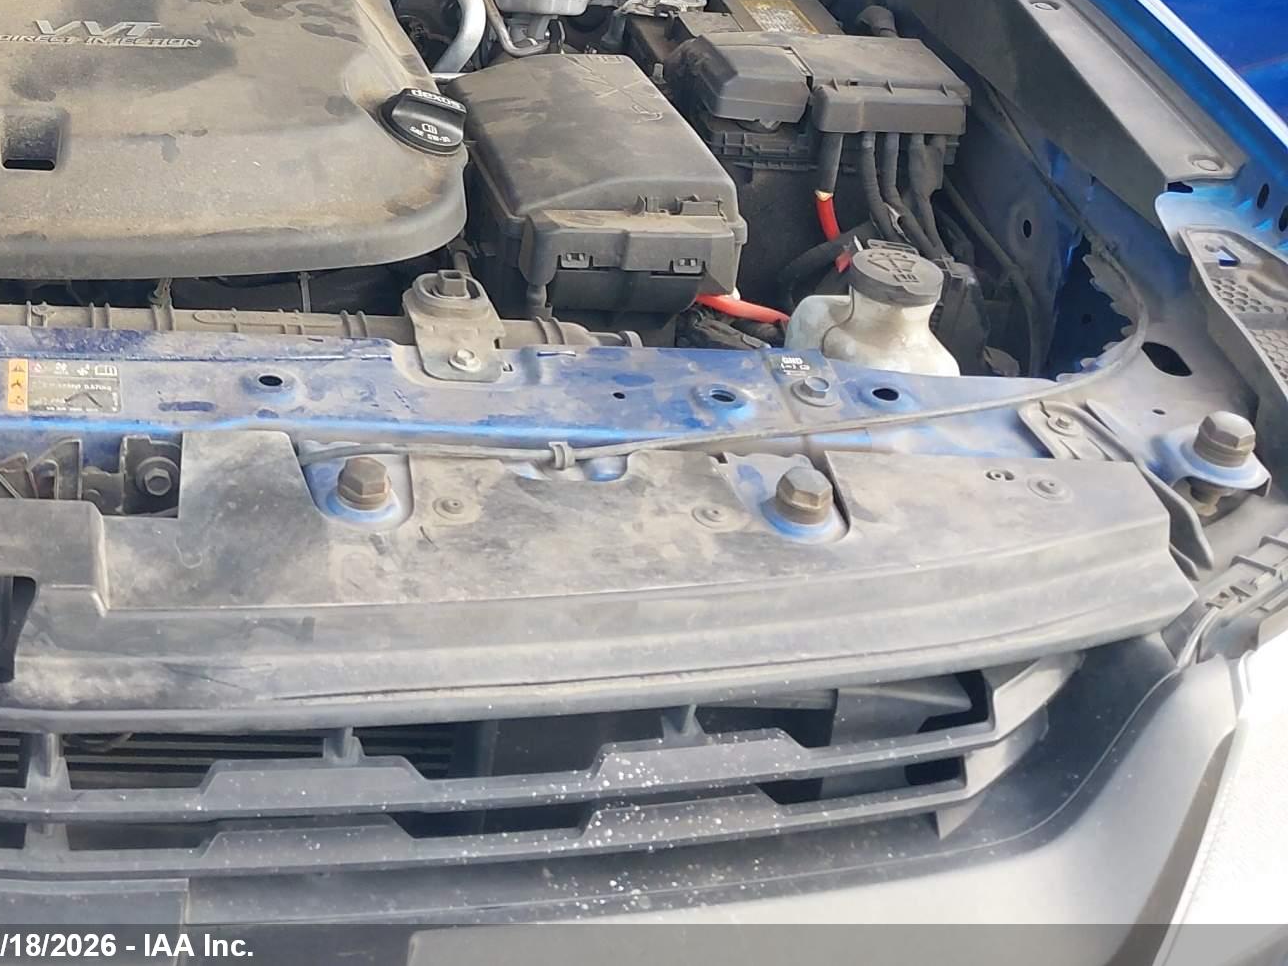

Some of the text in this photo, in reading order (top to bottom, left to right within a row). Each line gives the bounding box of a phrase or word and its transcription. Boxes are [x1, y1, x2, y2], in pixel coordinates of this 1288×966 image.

[34, 20, 162, 36] VVT
[85, 35, 202, 48] INJECTION
[411, 89, 461, 109] dexos
